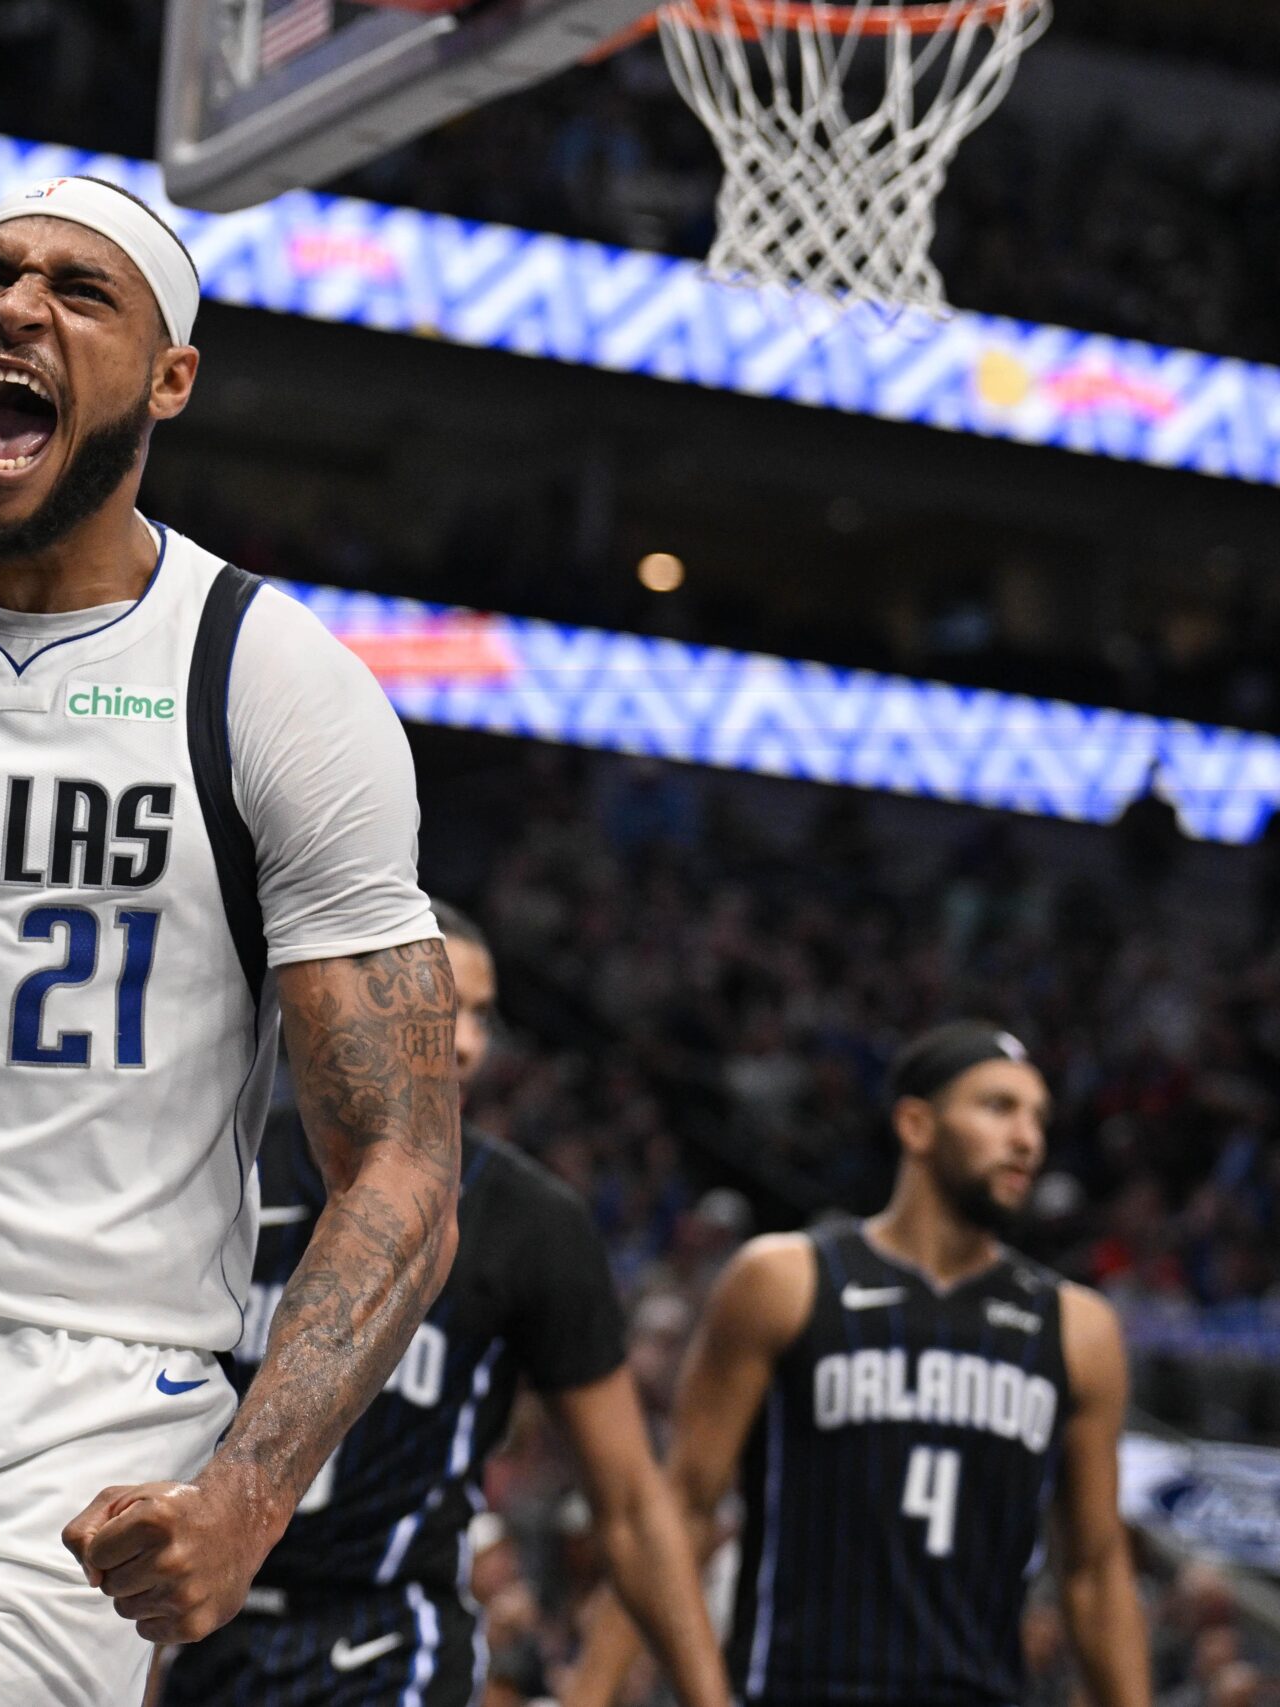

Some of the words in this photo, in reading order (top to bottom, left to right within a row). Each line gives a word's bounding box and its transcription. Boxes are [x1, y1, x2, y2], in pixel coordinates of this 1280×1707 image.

[69, 686, 175, 718] chime
[7, 903, 162, 1068] 21
[814, 1348, 1058, 1453] ORLANDO
[901, 1446, 961, 1557] 4
